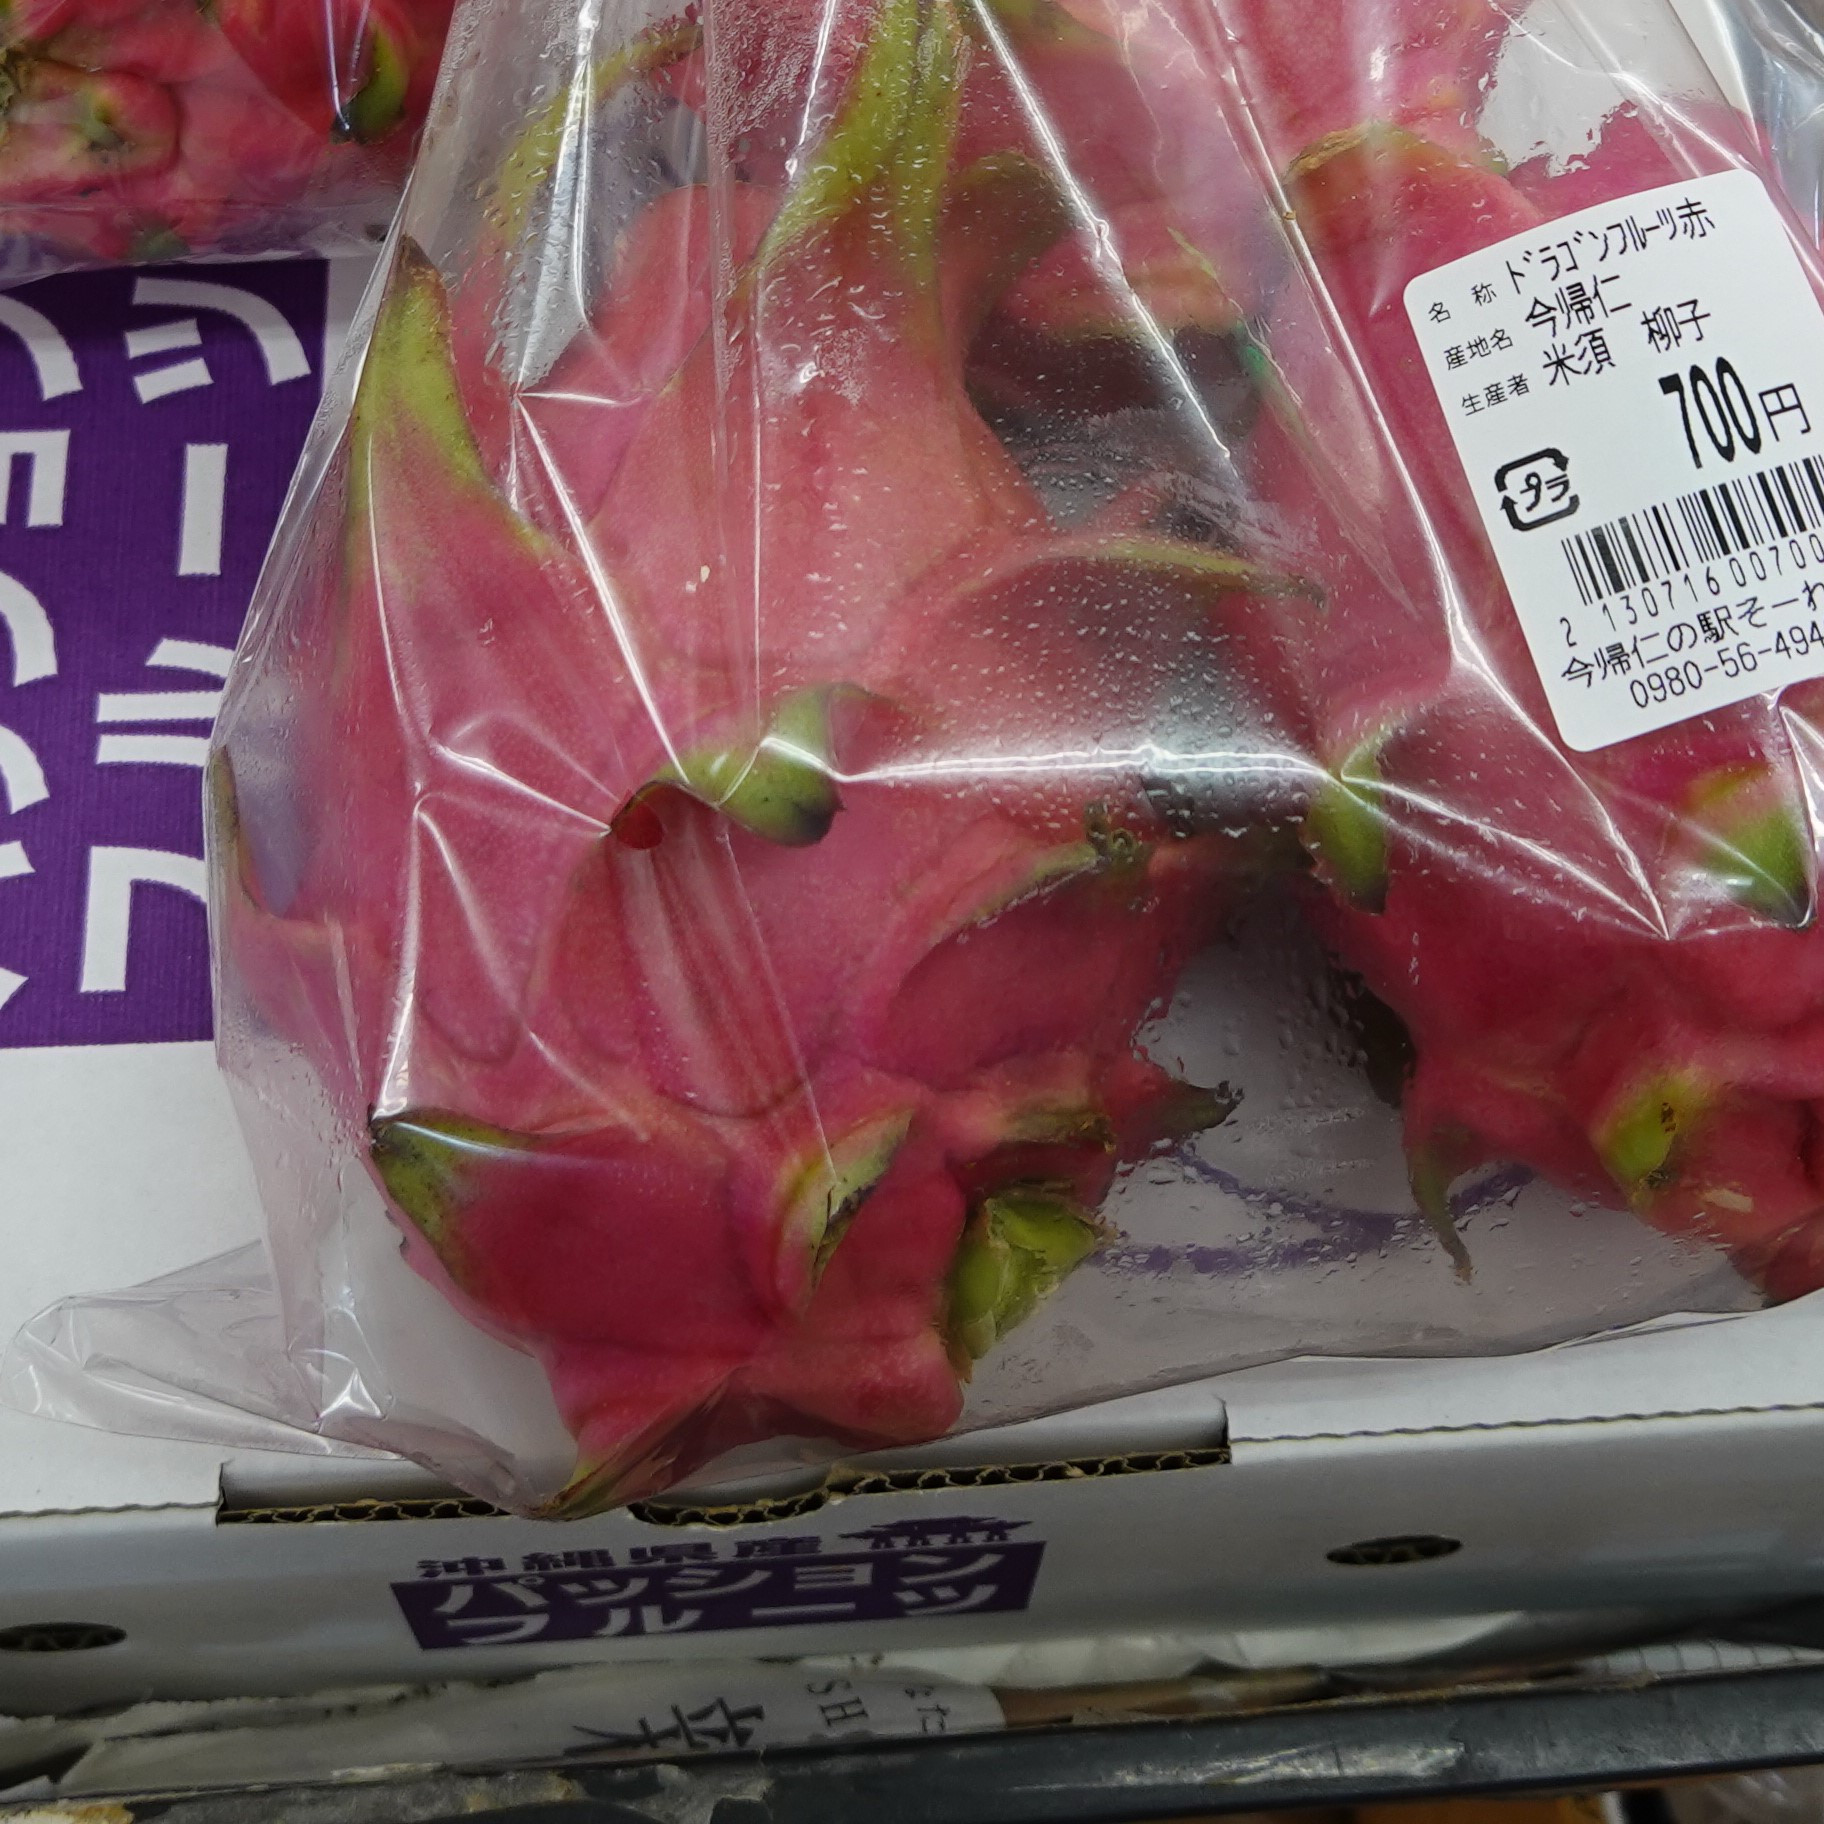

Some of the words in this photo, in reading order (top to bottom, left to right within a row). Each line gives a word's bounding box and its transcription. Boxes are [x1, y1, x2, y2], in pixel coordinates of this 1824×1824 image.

[1443, 327, 1515, 373] 産地名
[1523, 273, 1634, 339] 今帰仁
[1460, 373, 1531, 418] 生産者
[1540, 327, 1618, 388] 米須
[1639, 298, 1712, 355] 柳子
[1657, 356, 1812, 469] 700円
[415, 1533, 824, 1579] 沖縄県産
[430, 1550, 1008, 1614] パッション
[442, 1582, 998, 1646] フルーツ
